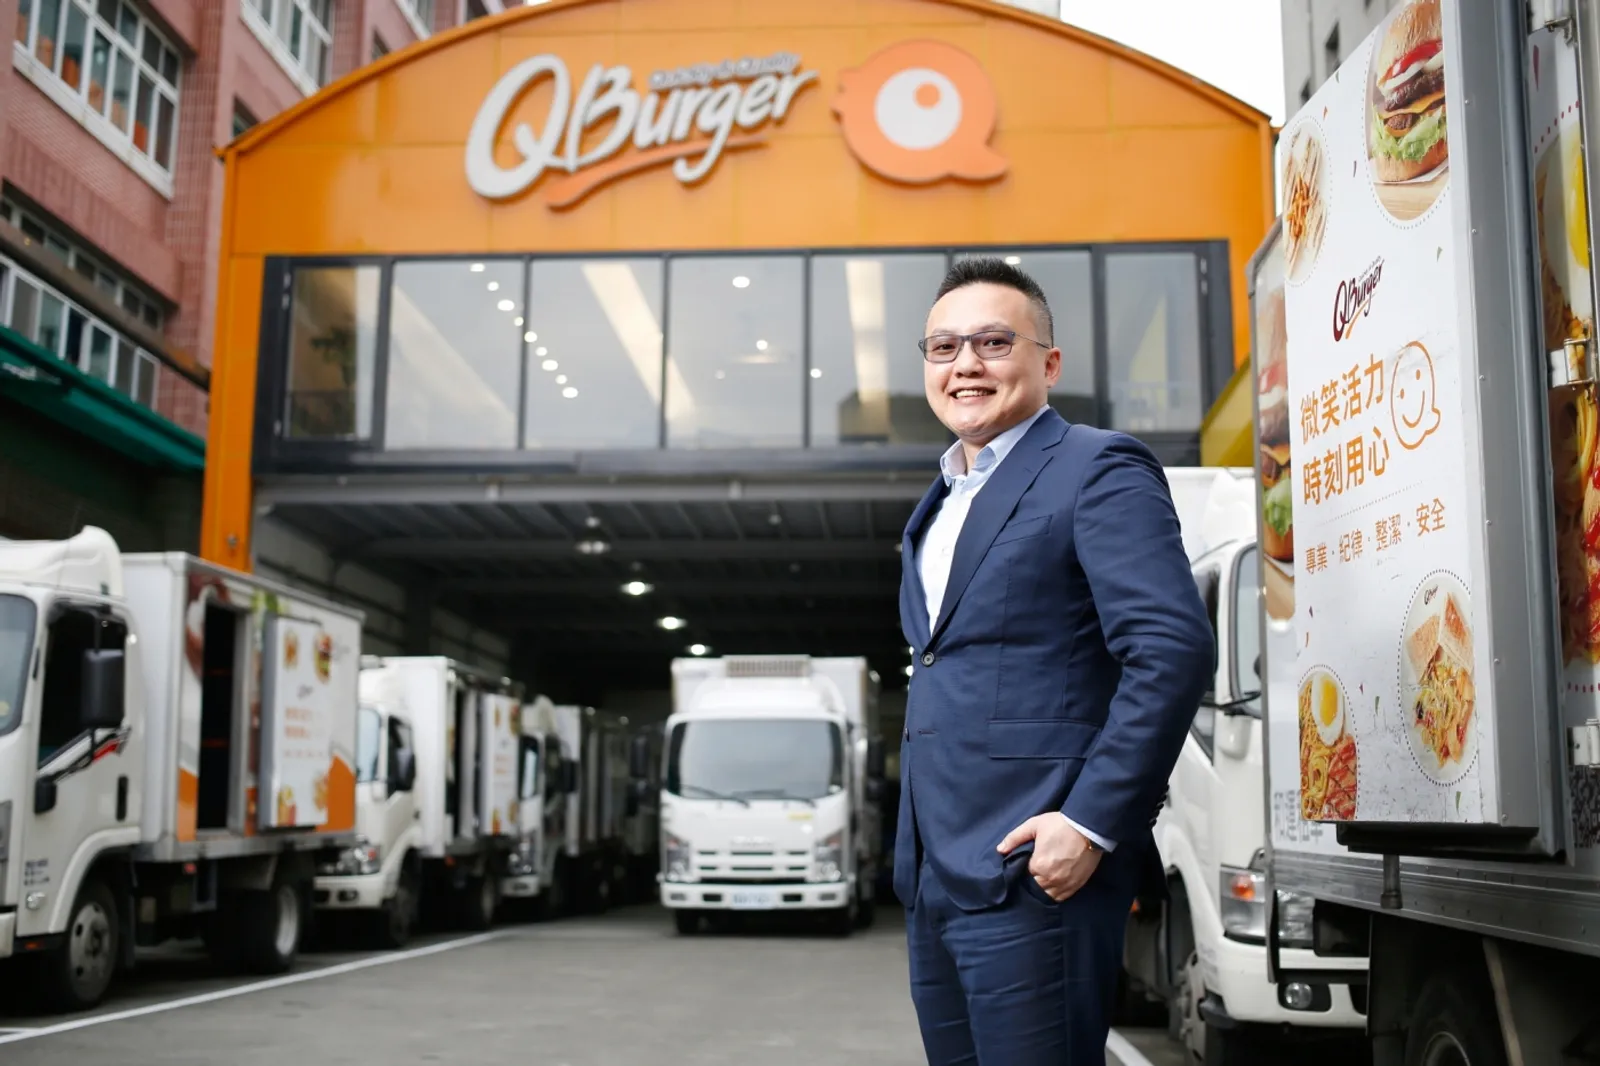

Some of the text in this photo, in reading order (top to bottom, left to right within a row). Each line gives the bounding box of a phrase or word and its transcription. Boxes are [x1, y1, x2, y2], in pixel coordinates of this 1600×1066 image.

[464, 53, 819, 200] QBurger
[1333, 258, 1385, 342] QBurger
[1300, 353, 1385, 445] 微笑活力
[1303, 426, 1390, 506] 時刻用心
